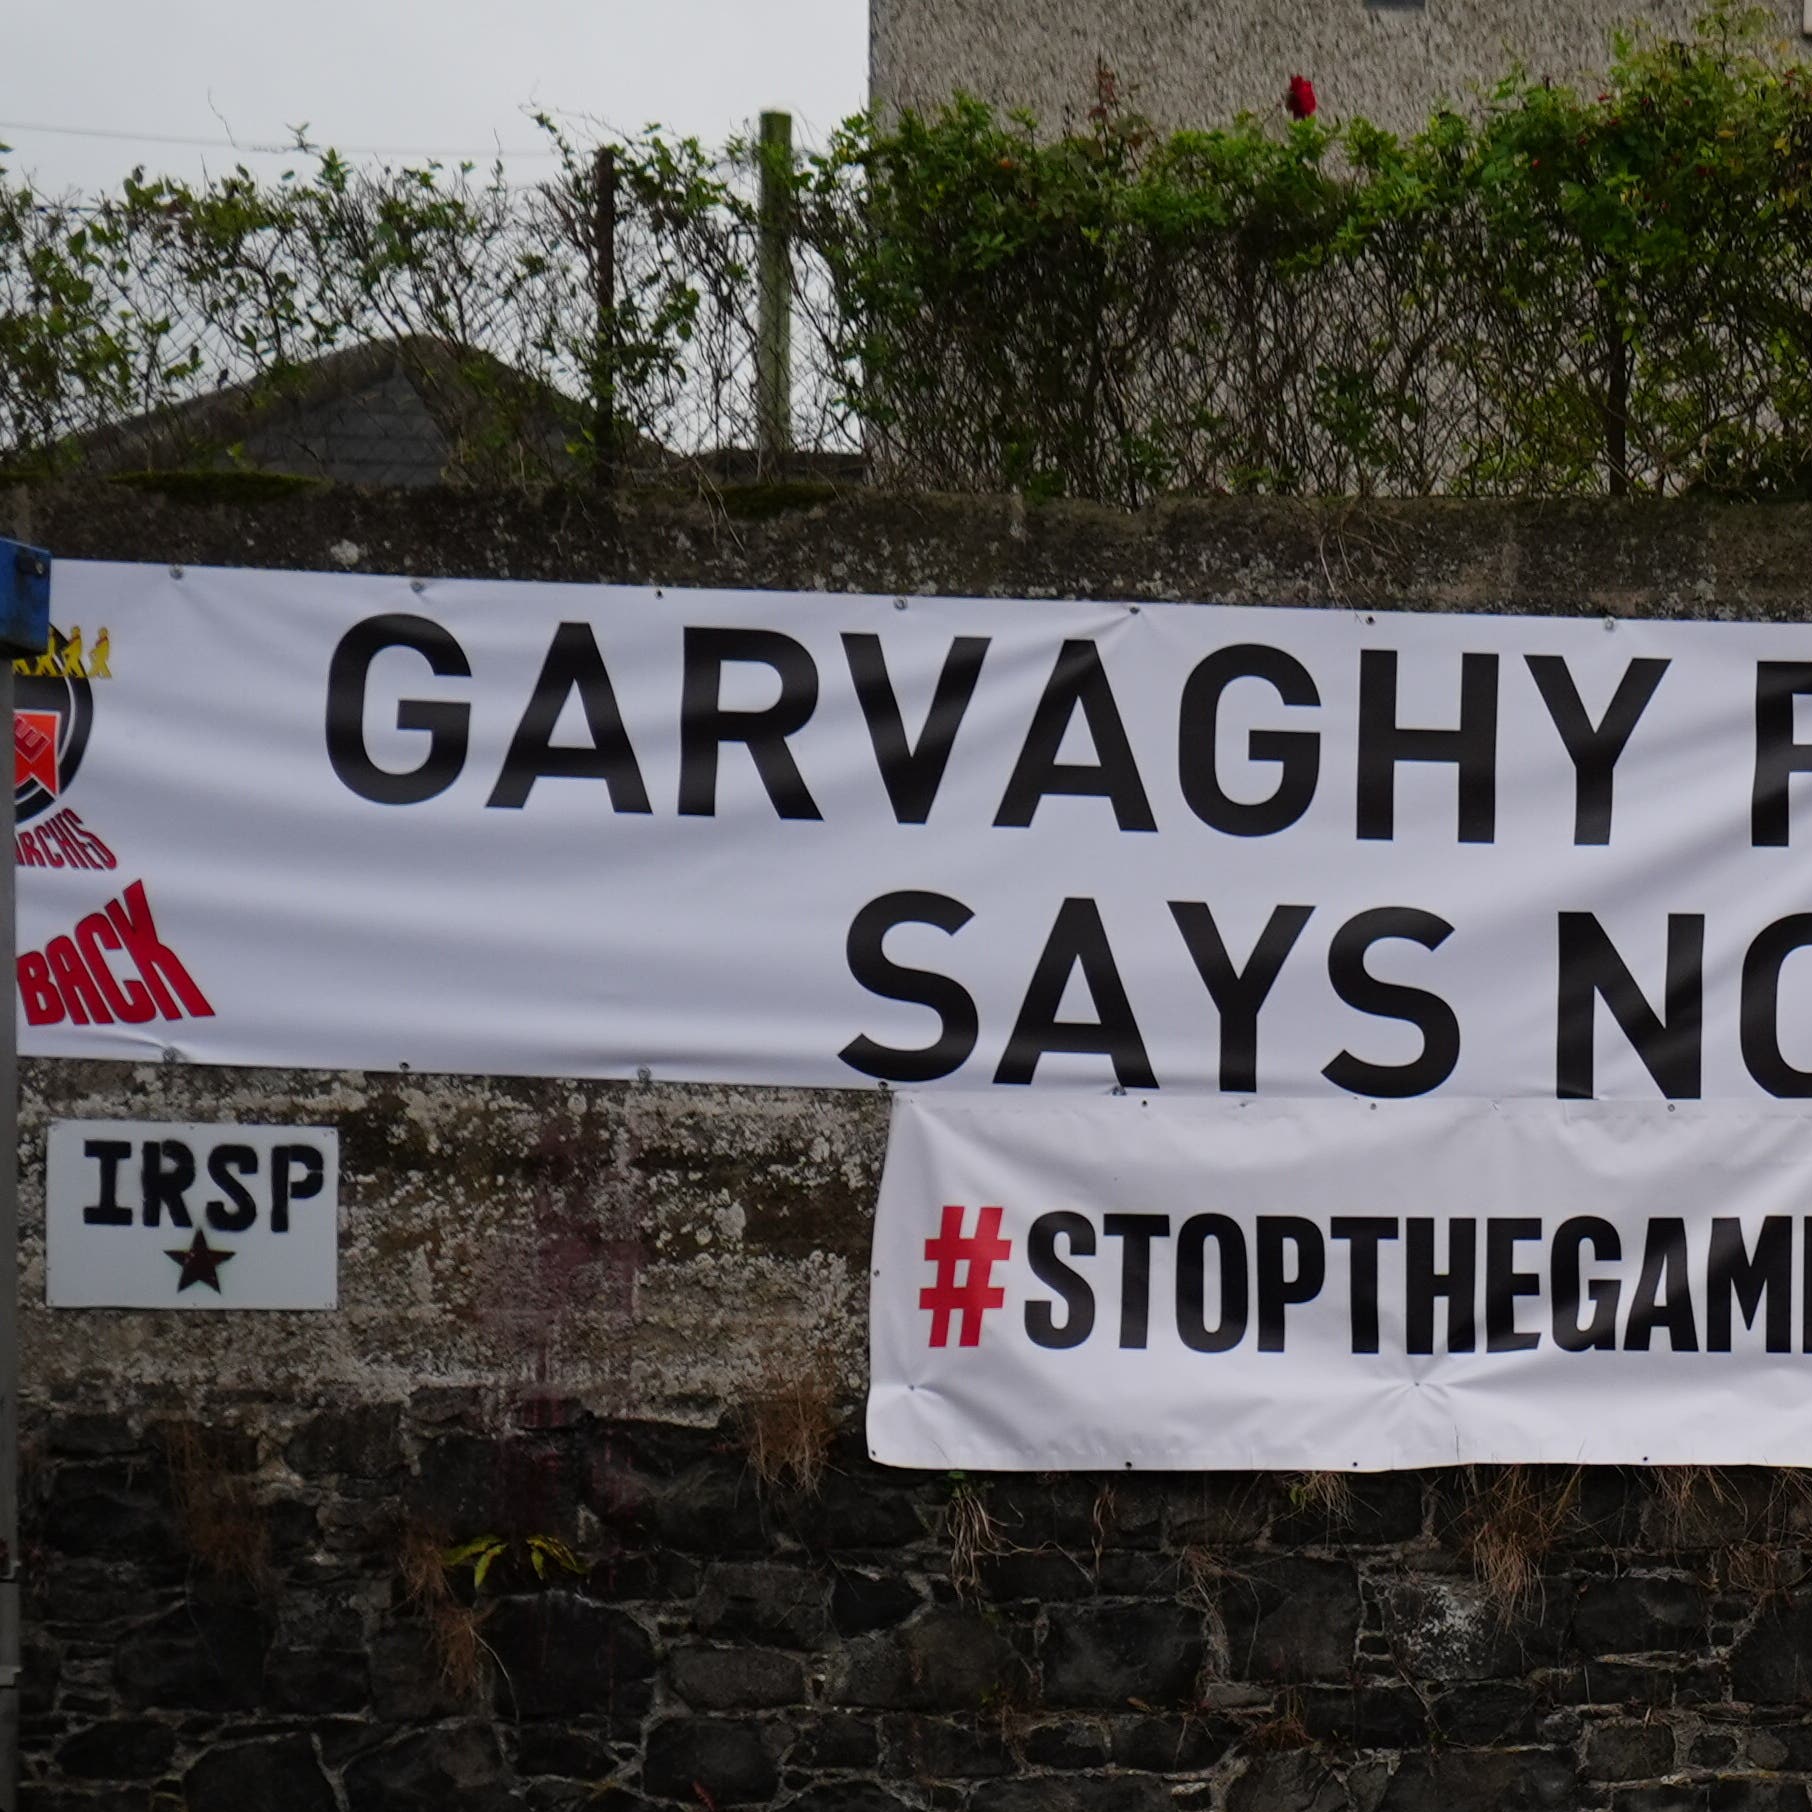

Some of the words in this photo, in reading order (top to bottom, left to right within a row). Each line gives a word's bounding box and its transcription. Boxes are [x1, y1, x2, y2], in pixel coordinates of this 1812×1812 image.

[325, 612, 1671, 846] GARVAGHY
[16, 879, 216, 1026] BACK
[836, 888, 1461, 1098] SAYS
[82, 1139, 325, 1234] IRSP
